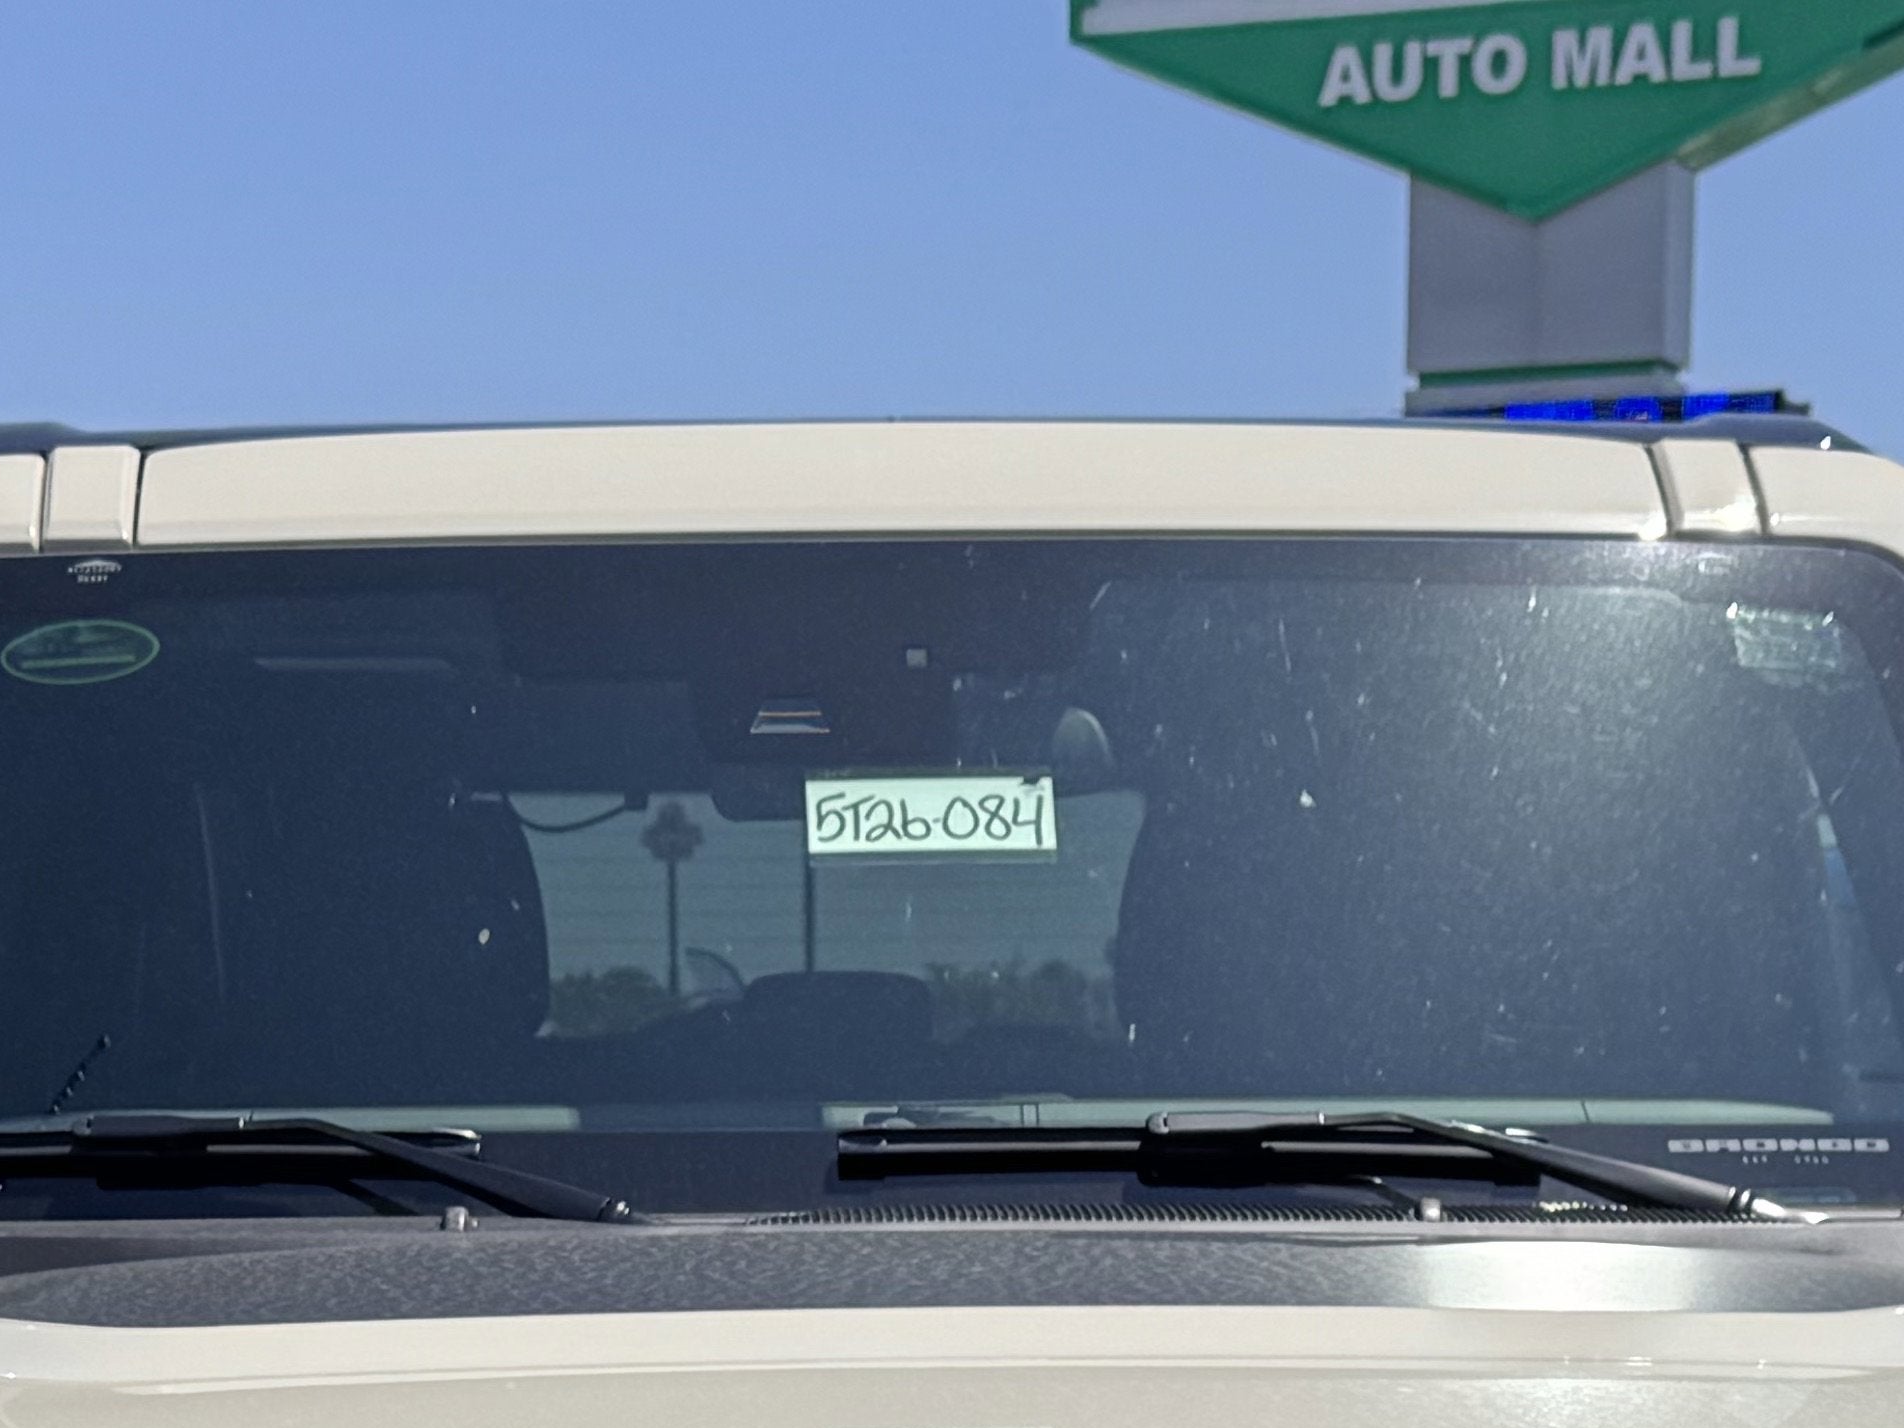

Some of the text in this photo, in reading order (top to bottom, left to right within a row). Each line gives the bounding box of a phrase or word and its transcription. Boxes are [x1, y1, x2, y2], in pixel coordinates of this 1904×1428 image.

[1317, 15, 1763, 107] AUTO MALL
[815, 791, 1045, 847] 5T26-084
